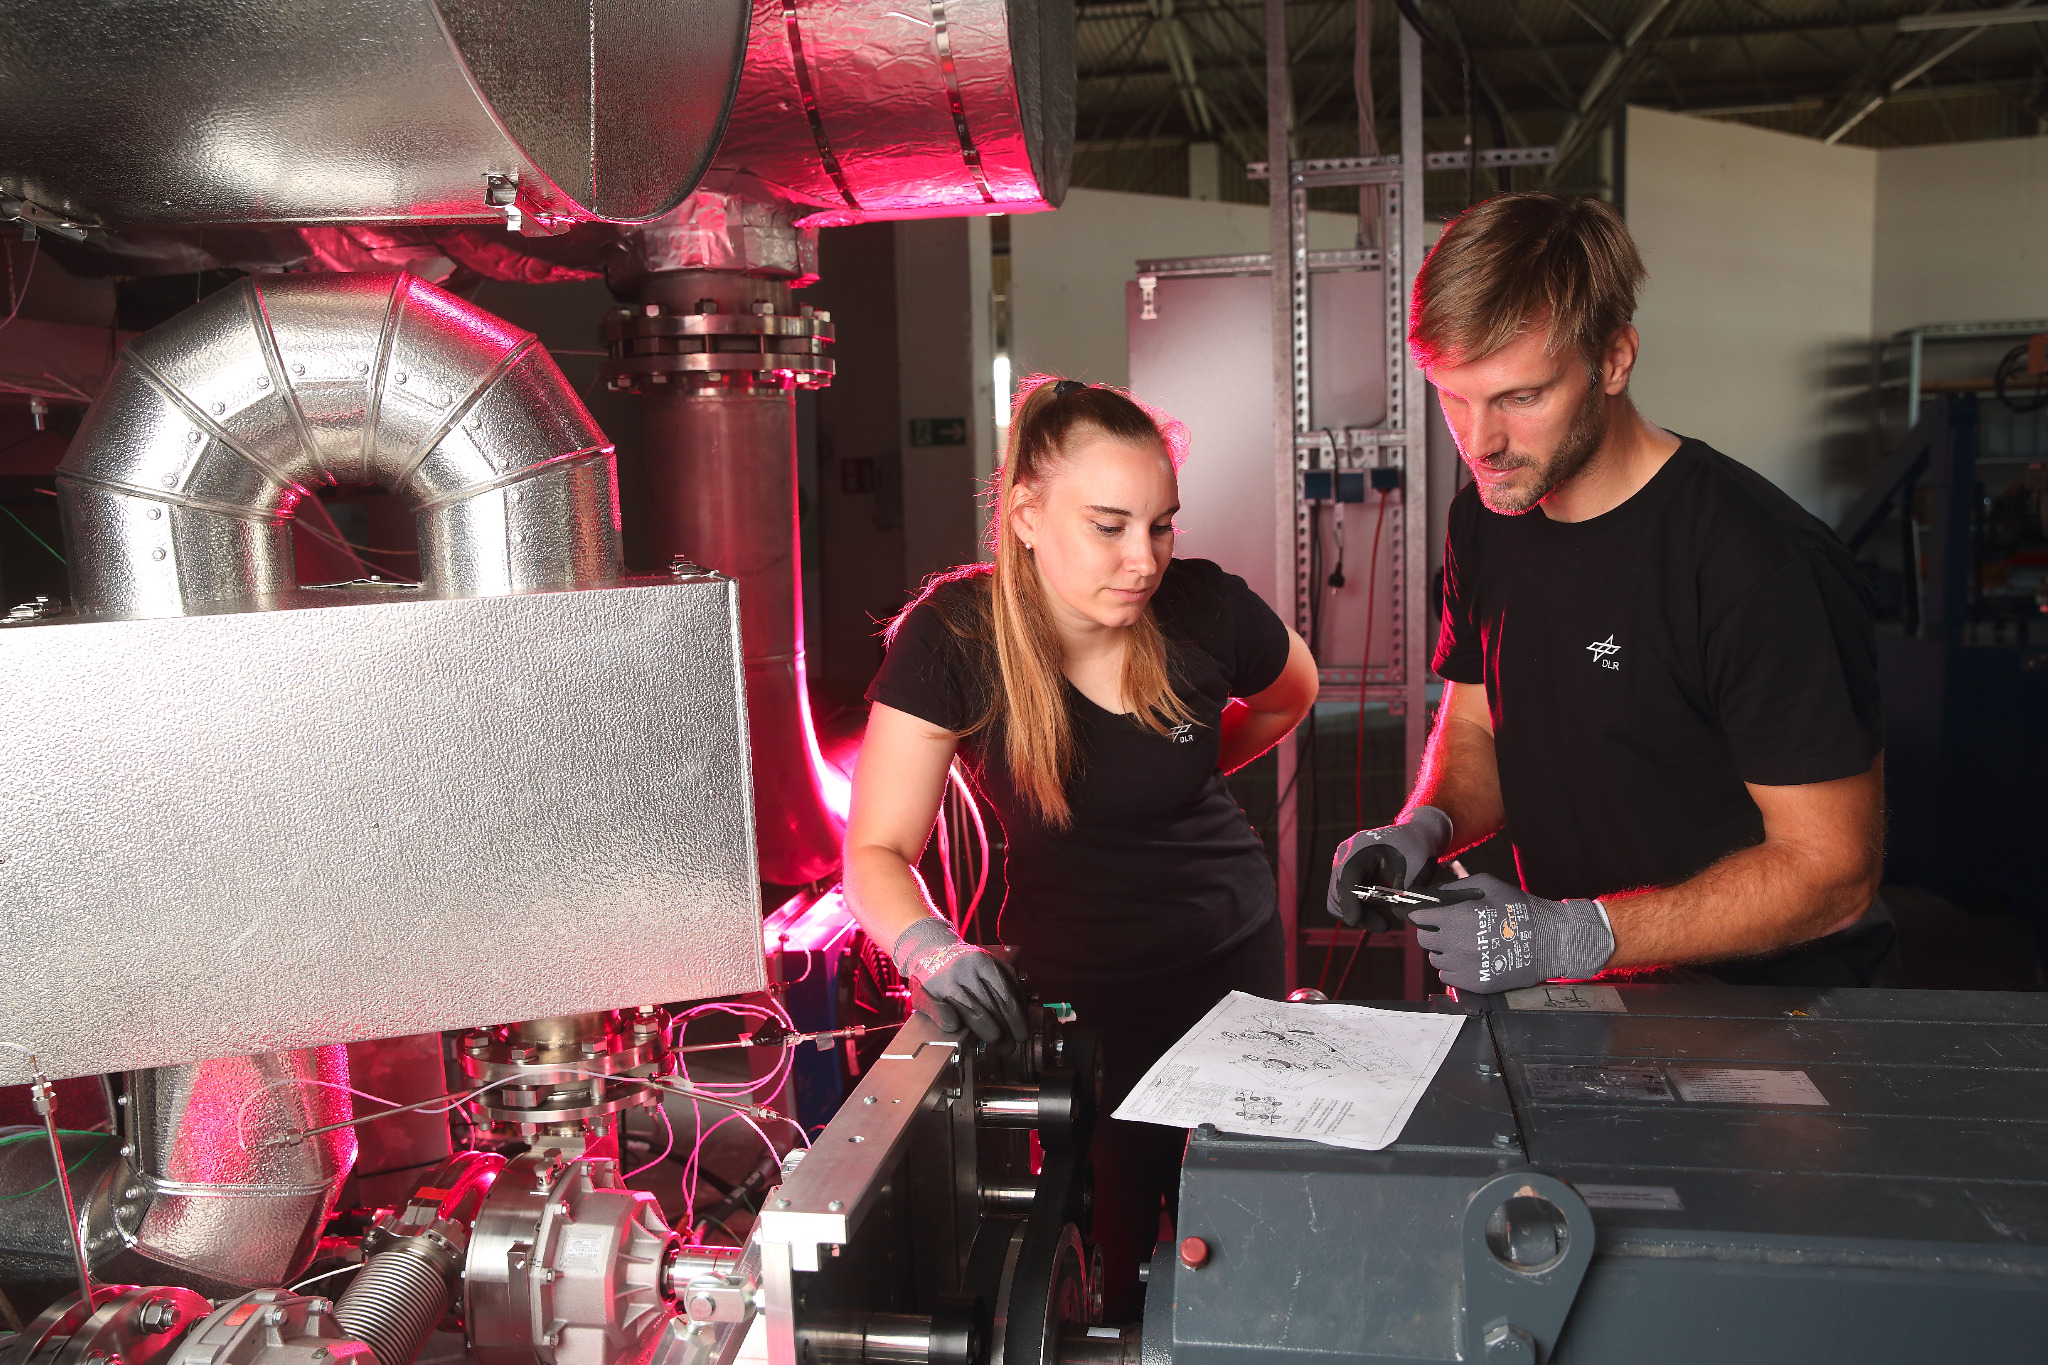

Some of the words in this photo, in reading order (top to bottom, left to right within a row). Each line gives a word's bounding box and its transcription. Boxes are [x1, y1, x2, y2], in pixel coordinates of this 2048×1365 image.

[1602, 659, 1619, 671] DLR
[1180, 734, 1194, 744] DLR
[1477, 909, 1491, 982] MaxiFlex
